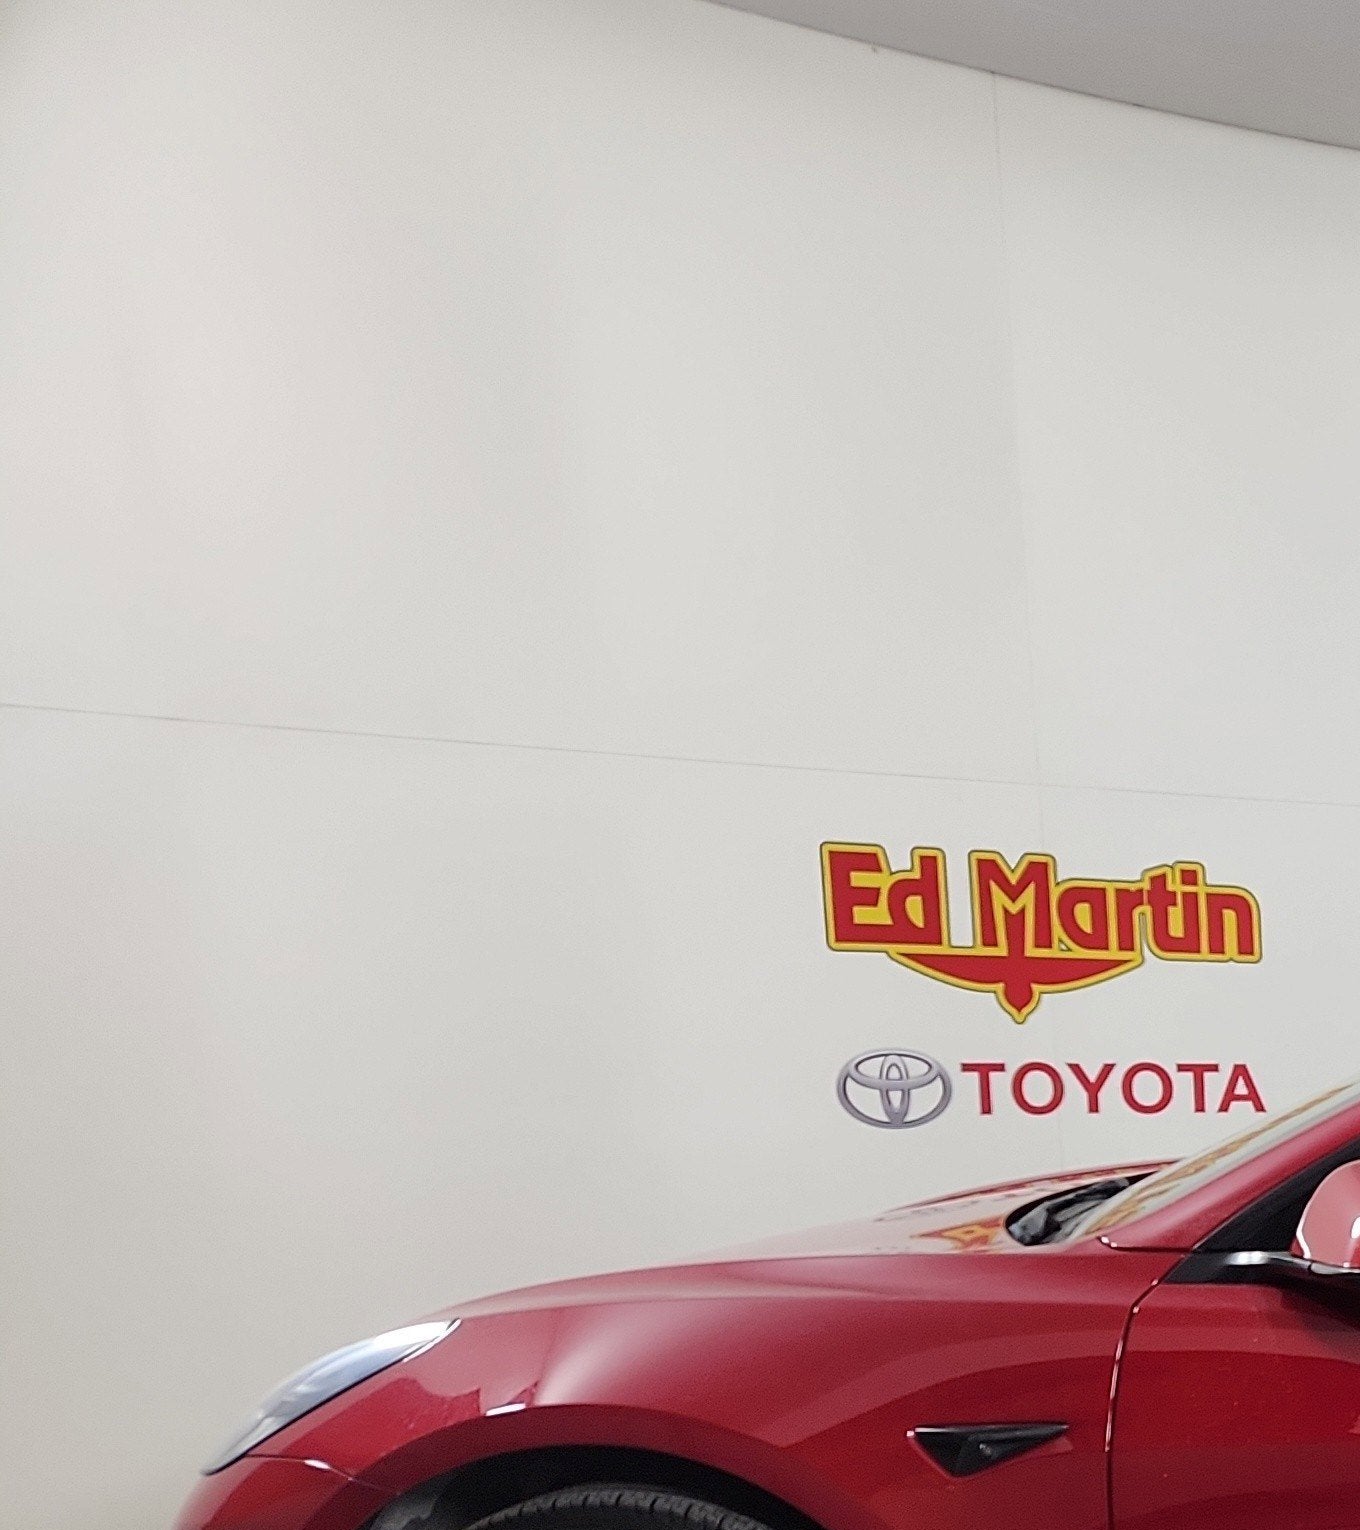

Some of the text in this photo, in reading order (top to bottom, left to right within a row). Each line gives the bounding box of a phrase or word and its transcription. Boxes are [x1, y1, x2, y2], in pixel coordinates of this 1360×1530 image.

[820, 843, 1262, 964] Ed Martin
[960, 1062, 1267, 1115] TOYOTA
